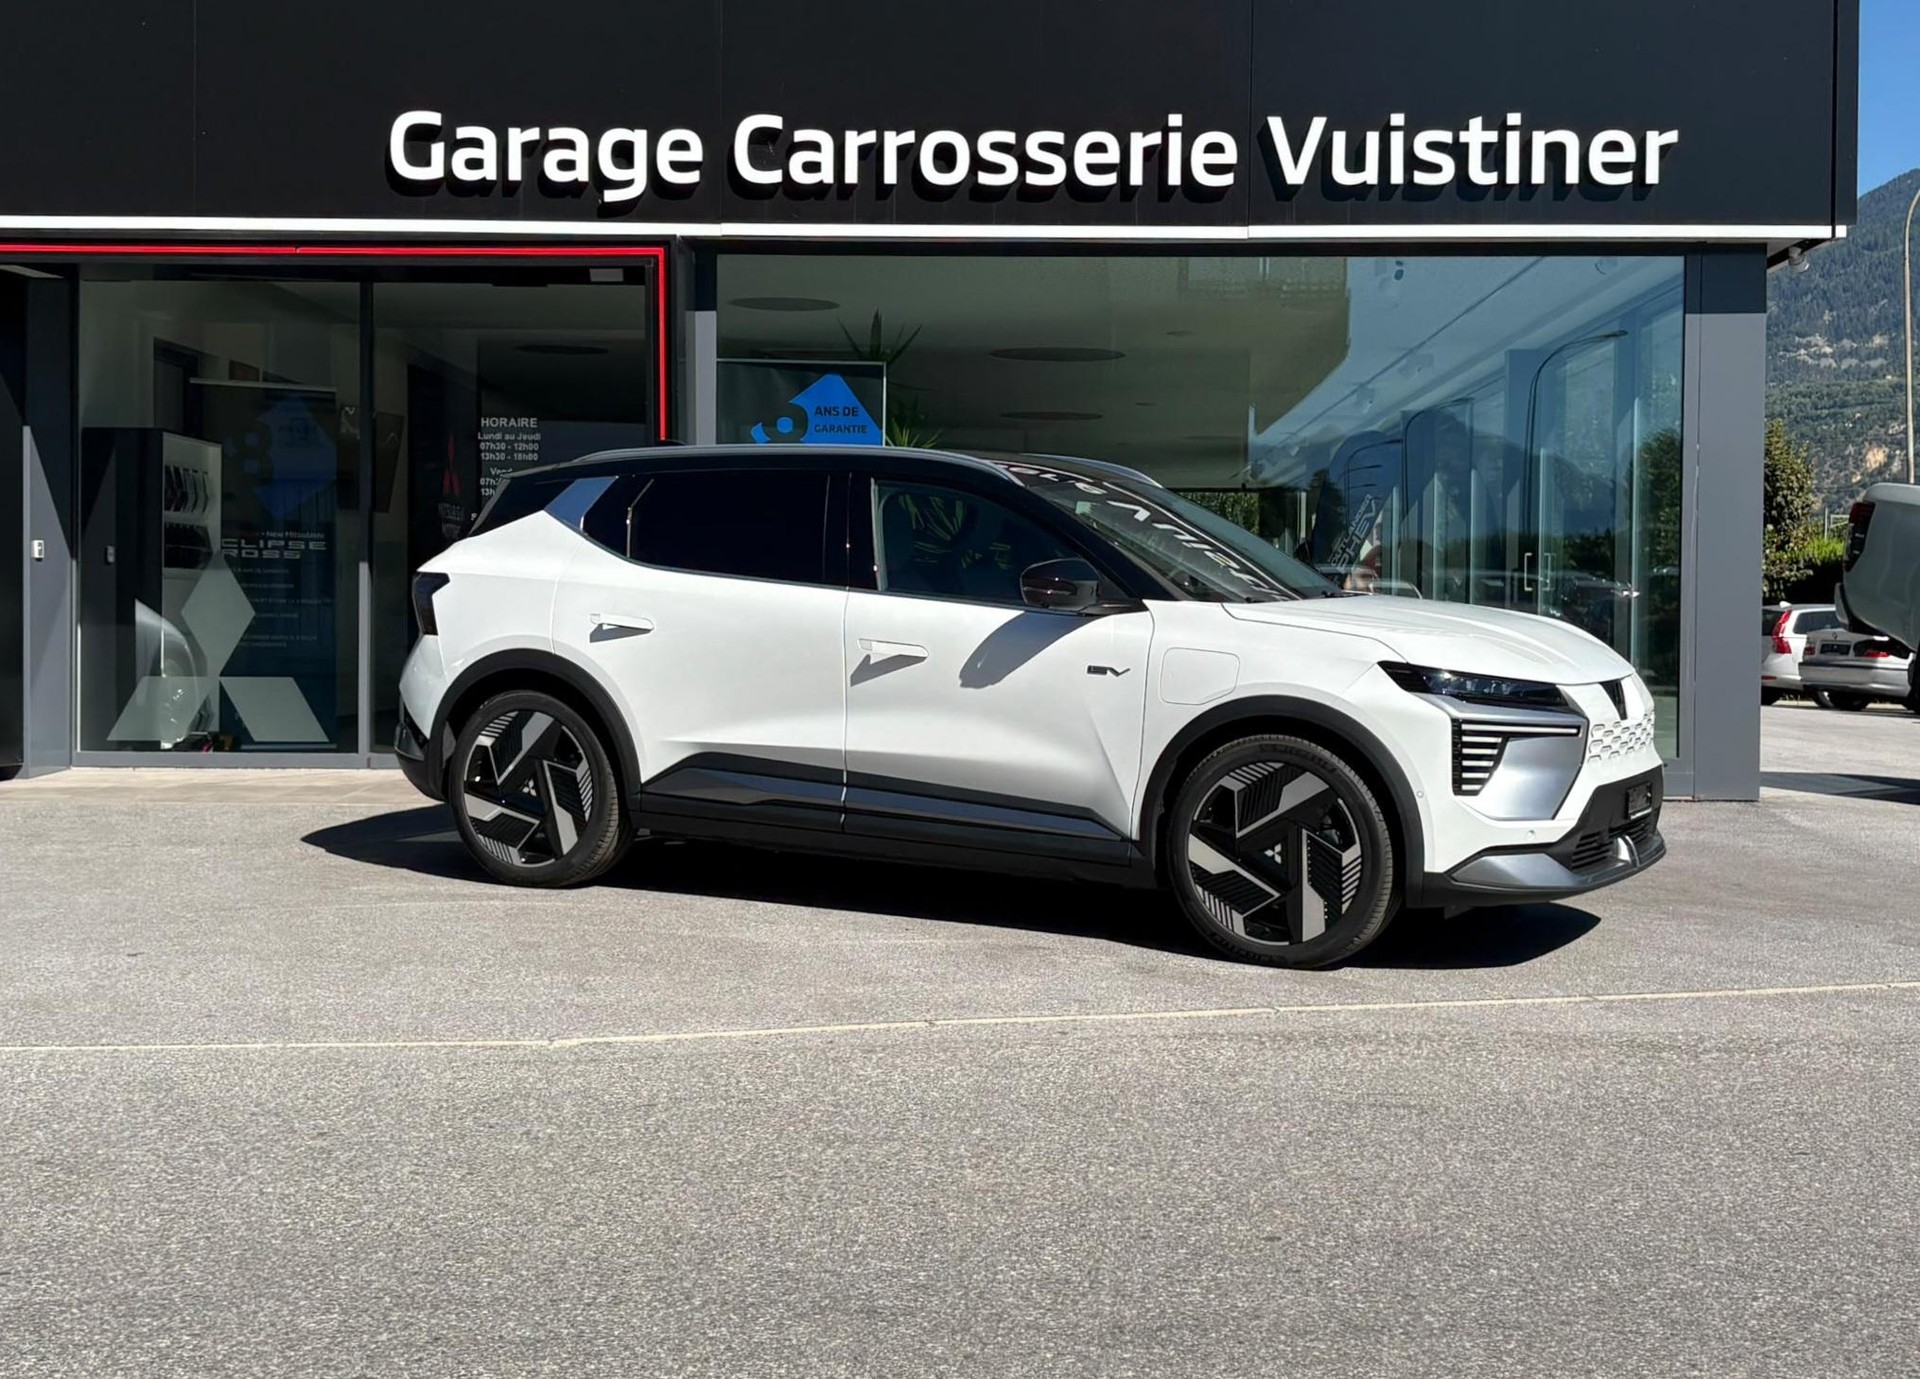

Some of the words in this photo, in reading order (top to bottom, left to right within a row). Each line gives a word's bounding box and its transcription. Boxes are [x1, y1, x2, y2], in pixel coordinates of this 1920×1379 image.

[391, 111, 702, 202] Garage
[735, 114, 1237, 186] Carrosserie
[1267, 113, 1678, 185] Vuistiner
[814, 406, 840, 416] ANS
[843, 407, 859, 416] DE
[481, 417, 538, 428] HORAIRE
[814, 424, 867, 433] GARANTIE
[477, 432, 503, 440] Lundi
[517, 432, 541, 440] Jeudi
[480, 442, 506, 451] 07h30
[514, 442, 539, 451] 12h00
[221, 538, 327, 550] CLIPSE
[221, 548, 302, 560] ROSS
